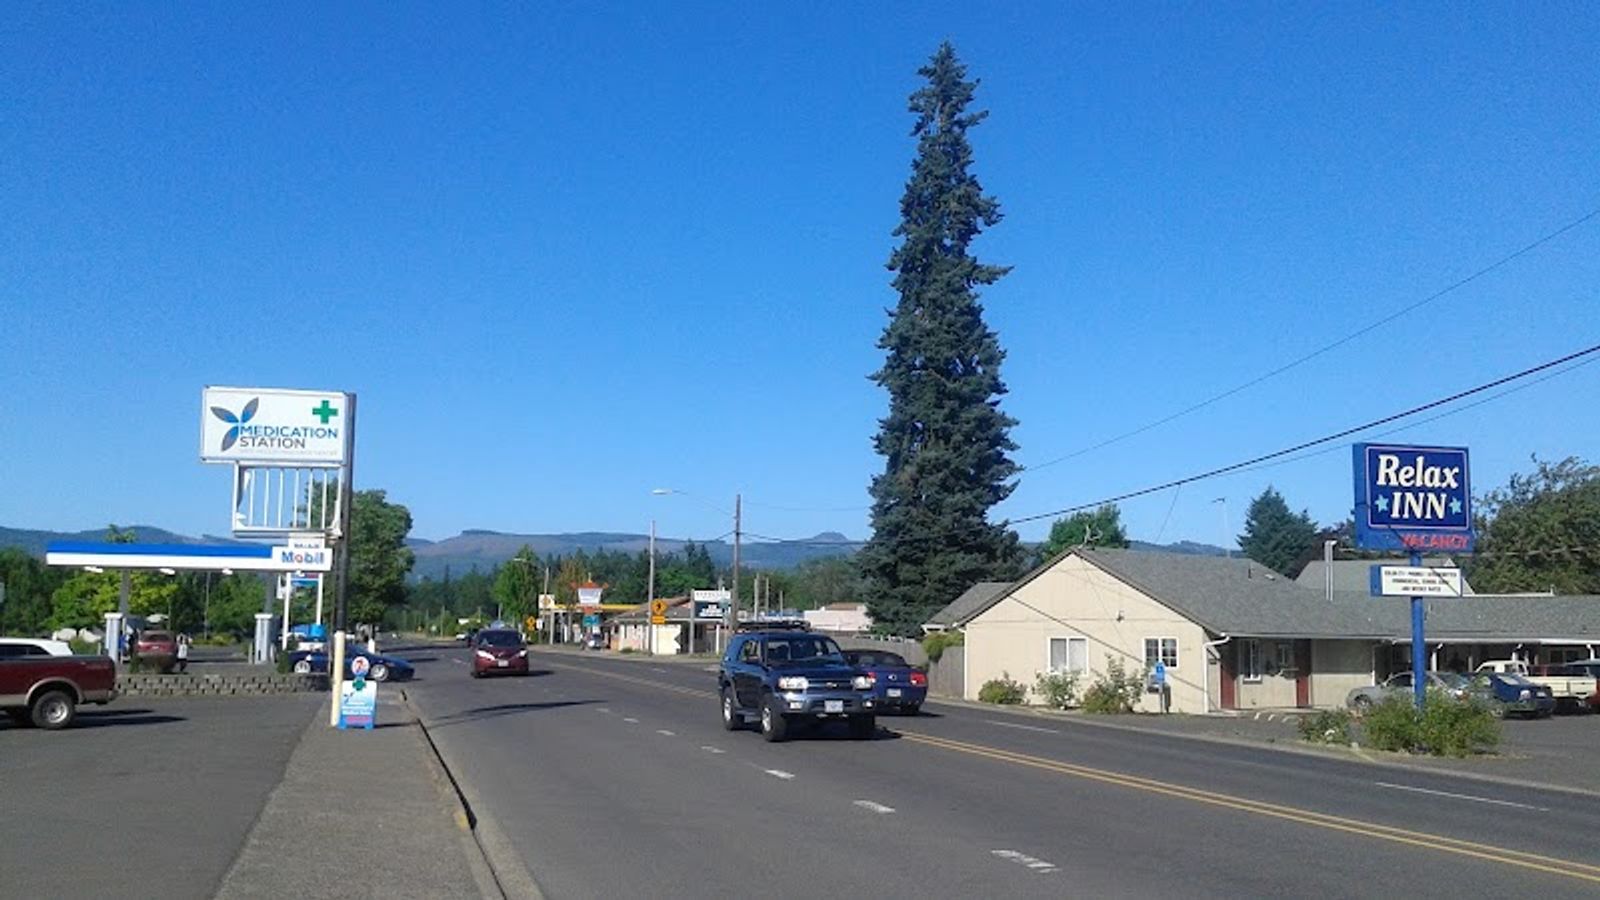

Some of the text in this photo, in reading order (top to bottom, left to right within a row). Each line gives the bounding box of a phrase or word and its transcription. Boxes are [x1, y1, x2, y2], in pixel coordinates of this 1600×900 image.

[239, 425, 338, 439] MEDICATION
[239, 437, 306, 449] STATION
[1376, 454, 1460, 489] Relax
[1390, 491, 1447, 520] INN
[1401, 533, 1469, 549] VACANCY
[281, 550, 324, 564] Mobil
